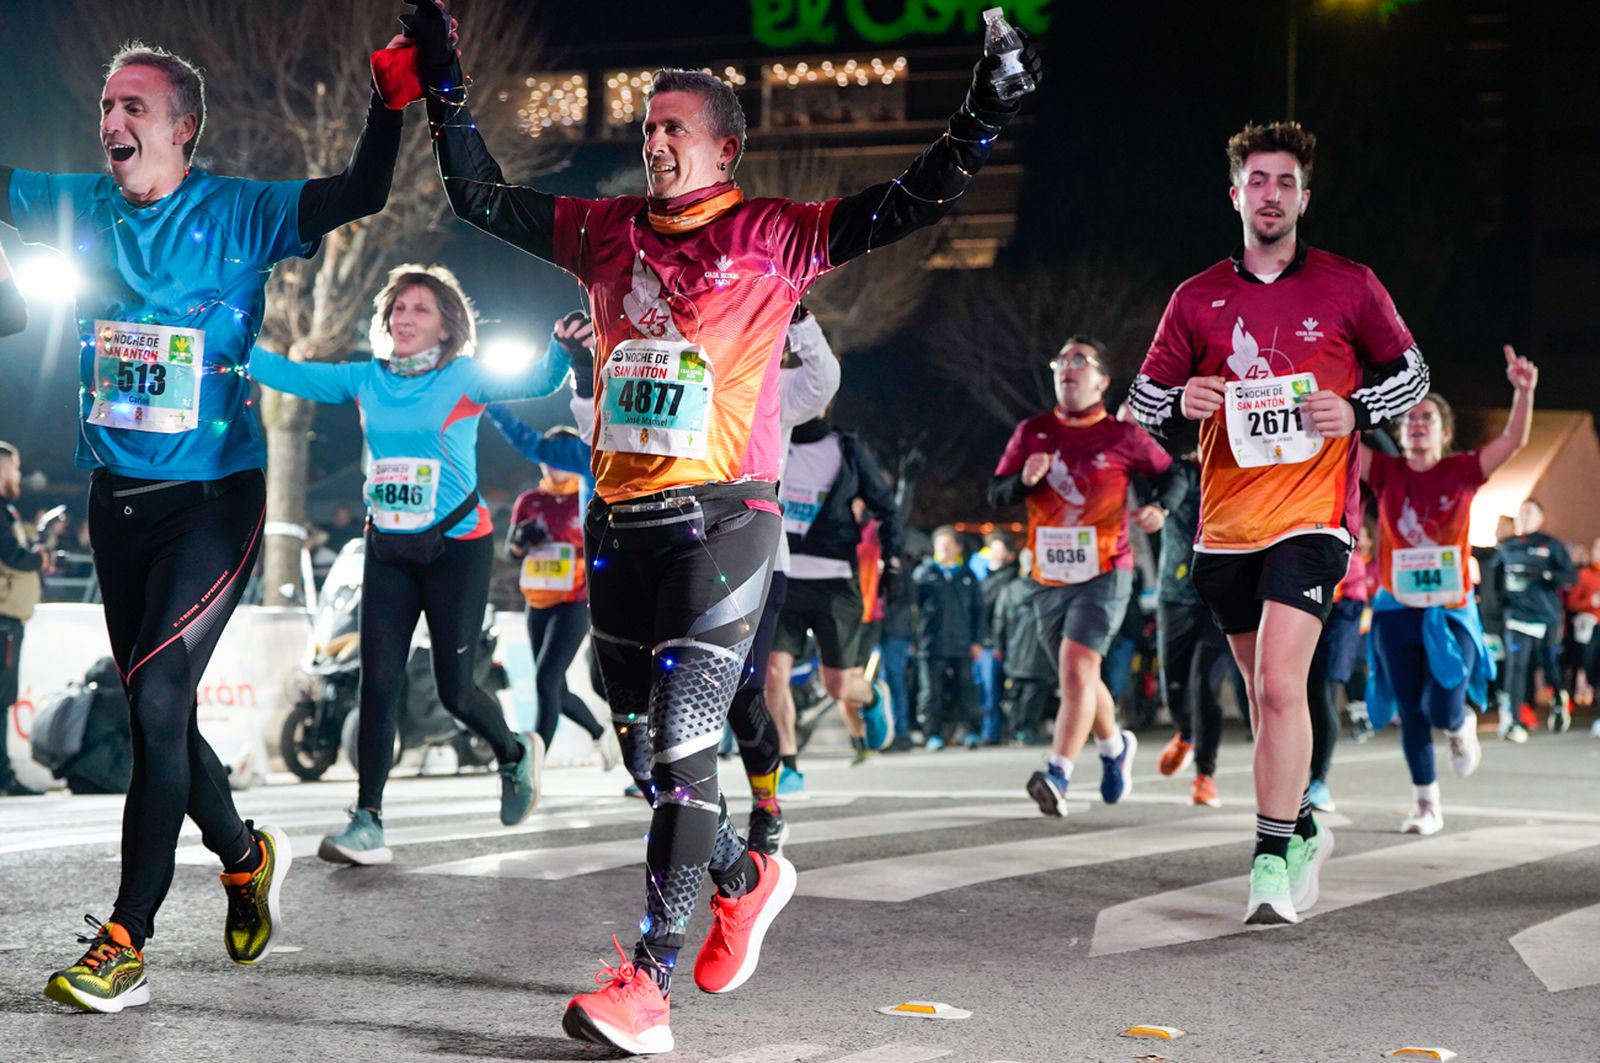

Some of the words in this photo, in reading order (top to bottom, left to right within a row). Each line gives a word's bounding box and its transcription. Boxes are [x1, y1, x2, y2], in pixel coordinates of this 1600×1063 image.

[844, 0, 1050, 42] Coe
[639, 308, 669, 336] 43
[114, 334, 146, 347] NOCHE
[147, 337, 159, 347] DE
[625, 352, 653, 363] NOCHE
[655, 354, 669, 365] DE
[118, 362, 166, 396] 513
[614, 366, 630, 377] SAN
[631, 364, 667, 379] ANTÓN
[618, 380, 685, 416] 4877
[1245, 390, 1271, 398] NOCHE
[1273, 387, 1283, 396] DE
[1237, 402, 1252, 410] SAN
[1248, 407, 1303, 437] 2671
[374, 484, 423, 505] 5846
[1046, 548, 1086, 564] 6036
[1412, 569, 1442, 588] 144
